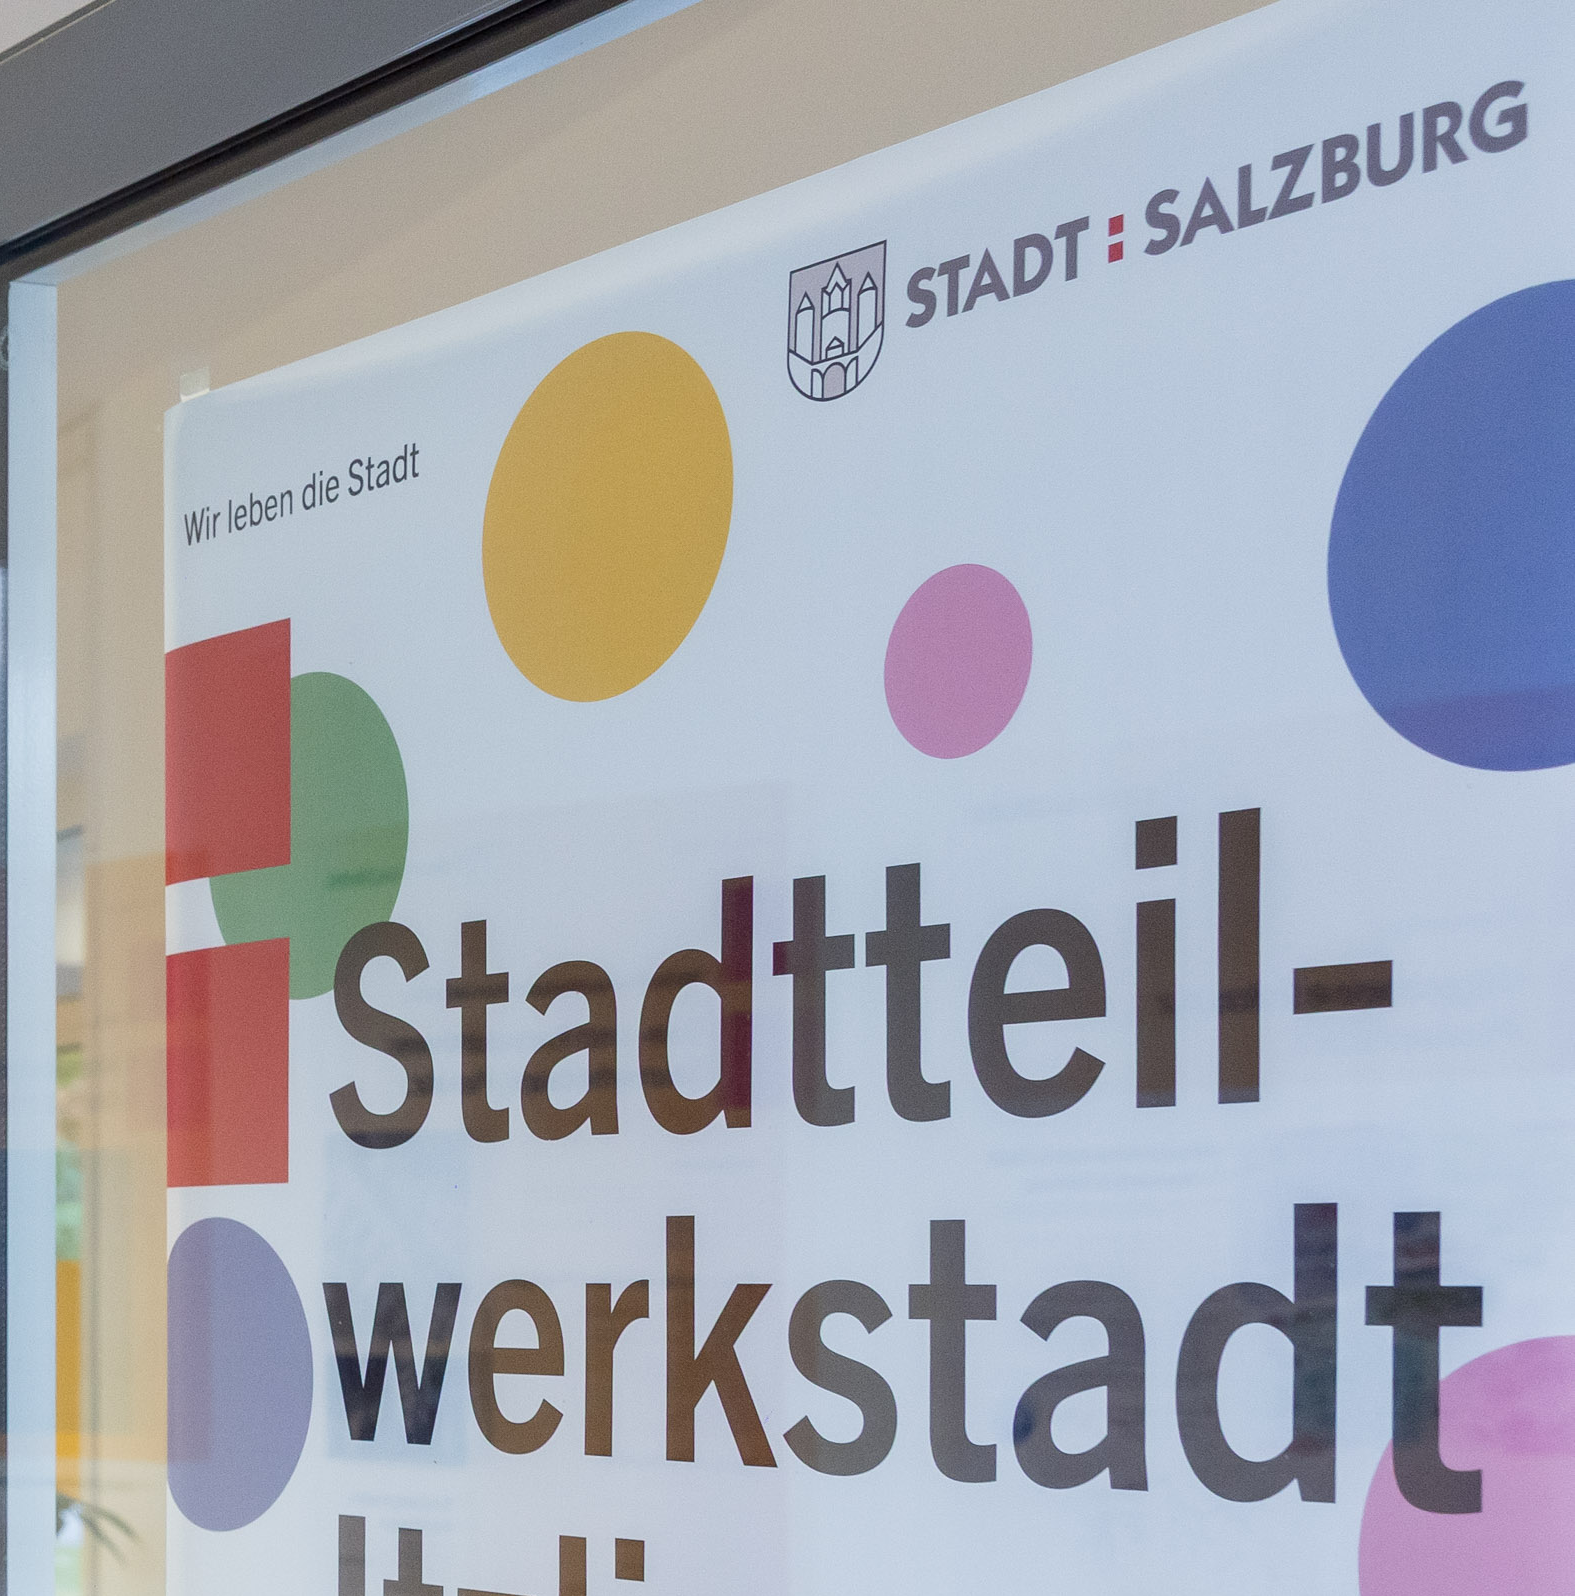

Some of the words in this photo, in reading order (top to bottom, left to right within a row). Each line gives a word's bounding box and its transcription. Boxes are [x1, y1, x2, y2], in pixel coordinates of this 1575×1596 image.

[905, 214, 1090, 329] STADT
[1143, 79, 1528, 257] SALZBURG
[184, 506, 221, 546] Wir
[228, 489, 293, 534] leben
[302, 470, 340, 511] die
[347, 442, 420, 497] Stadt
[328, 806, 1394, 1150] Stadtteil-
[321, 1202, 1484, 1515] werkstadt
